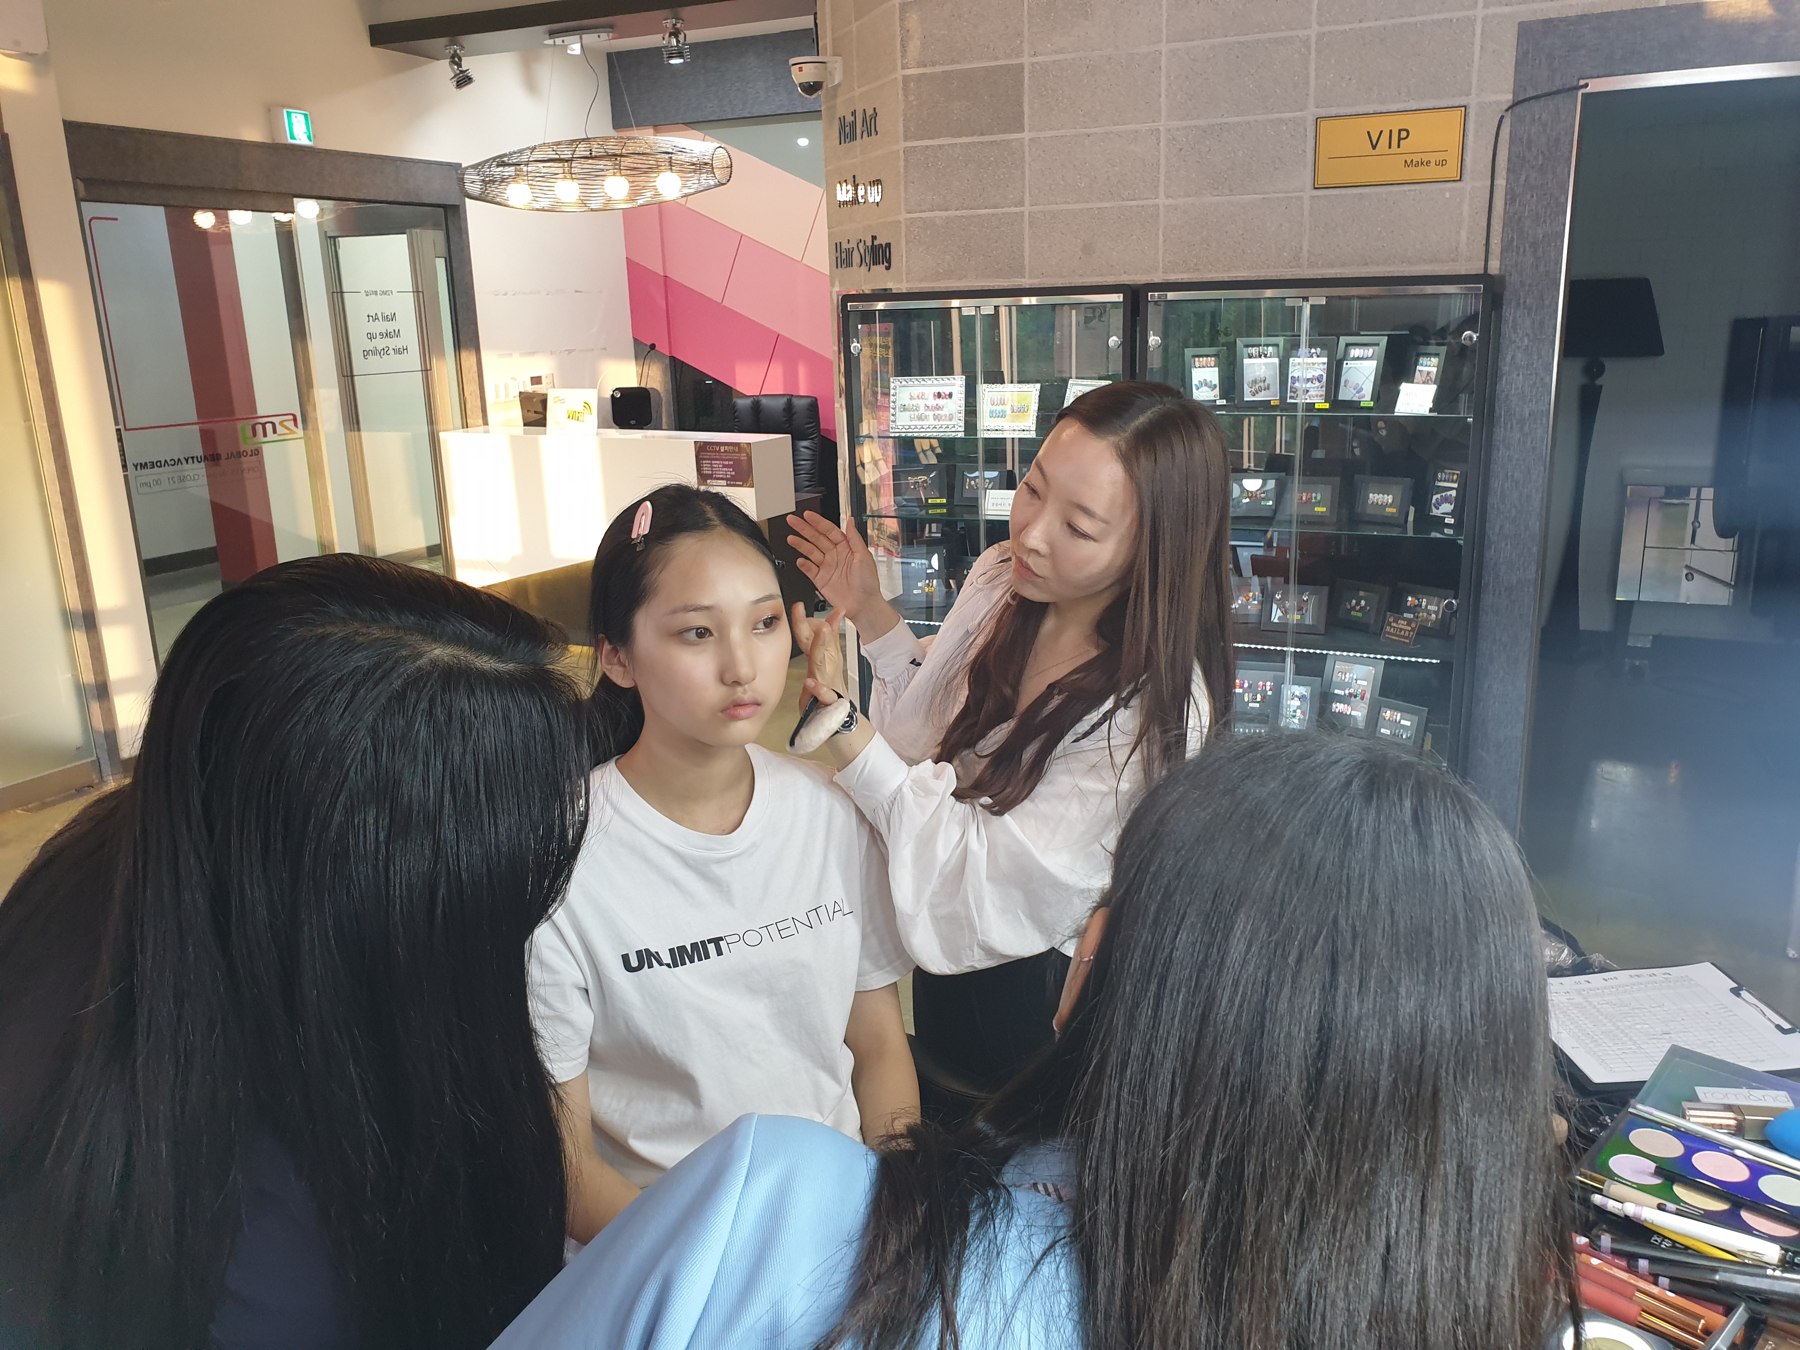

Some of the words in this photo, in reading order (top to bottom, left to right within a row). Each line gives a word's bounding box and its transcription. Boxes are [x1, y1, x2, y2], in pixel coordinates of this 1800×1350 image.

[838, 109, 857, 145] Nail
[861, 107, 878, 139] Art
[1366, 128, 1410, 151] VIP
[1404, 158, 1431, 168] Make
[1435, 158, 1448, 167] up
[837, 175, 866, 208] Make
[867, 178, 883, 207] up
[835, 239, 855, 269] Hair
[856, 235, 892, 272] Styling
